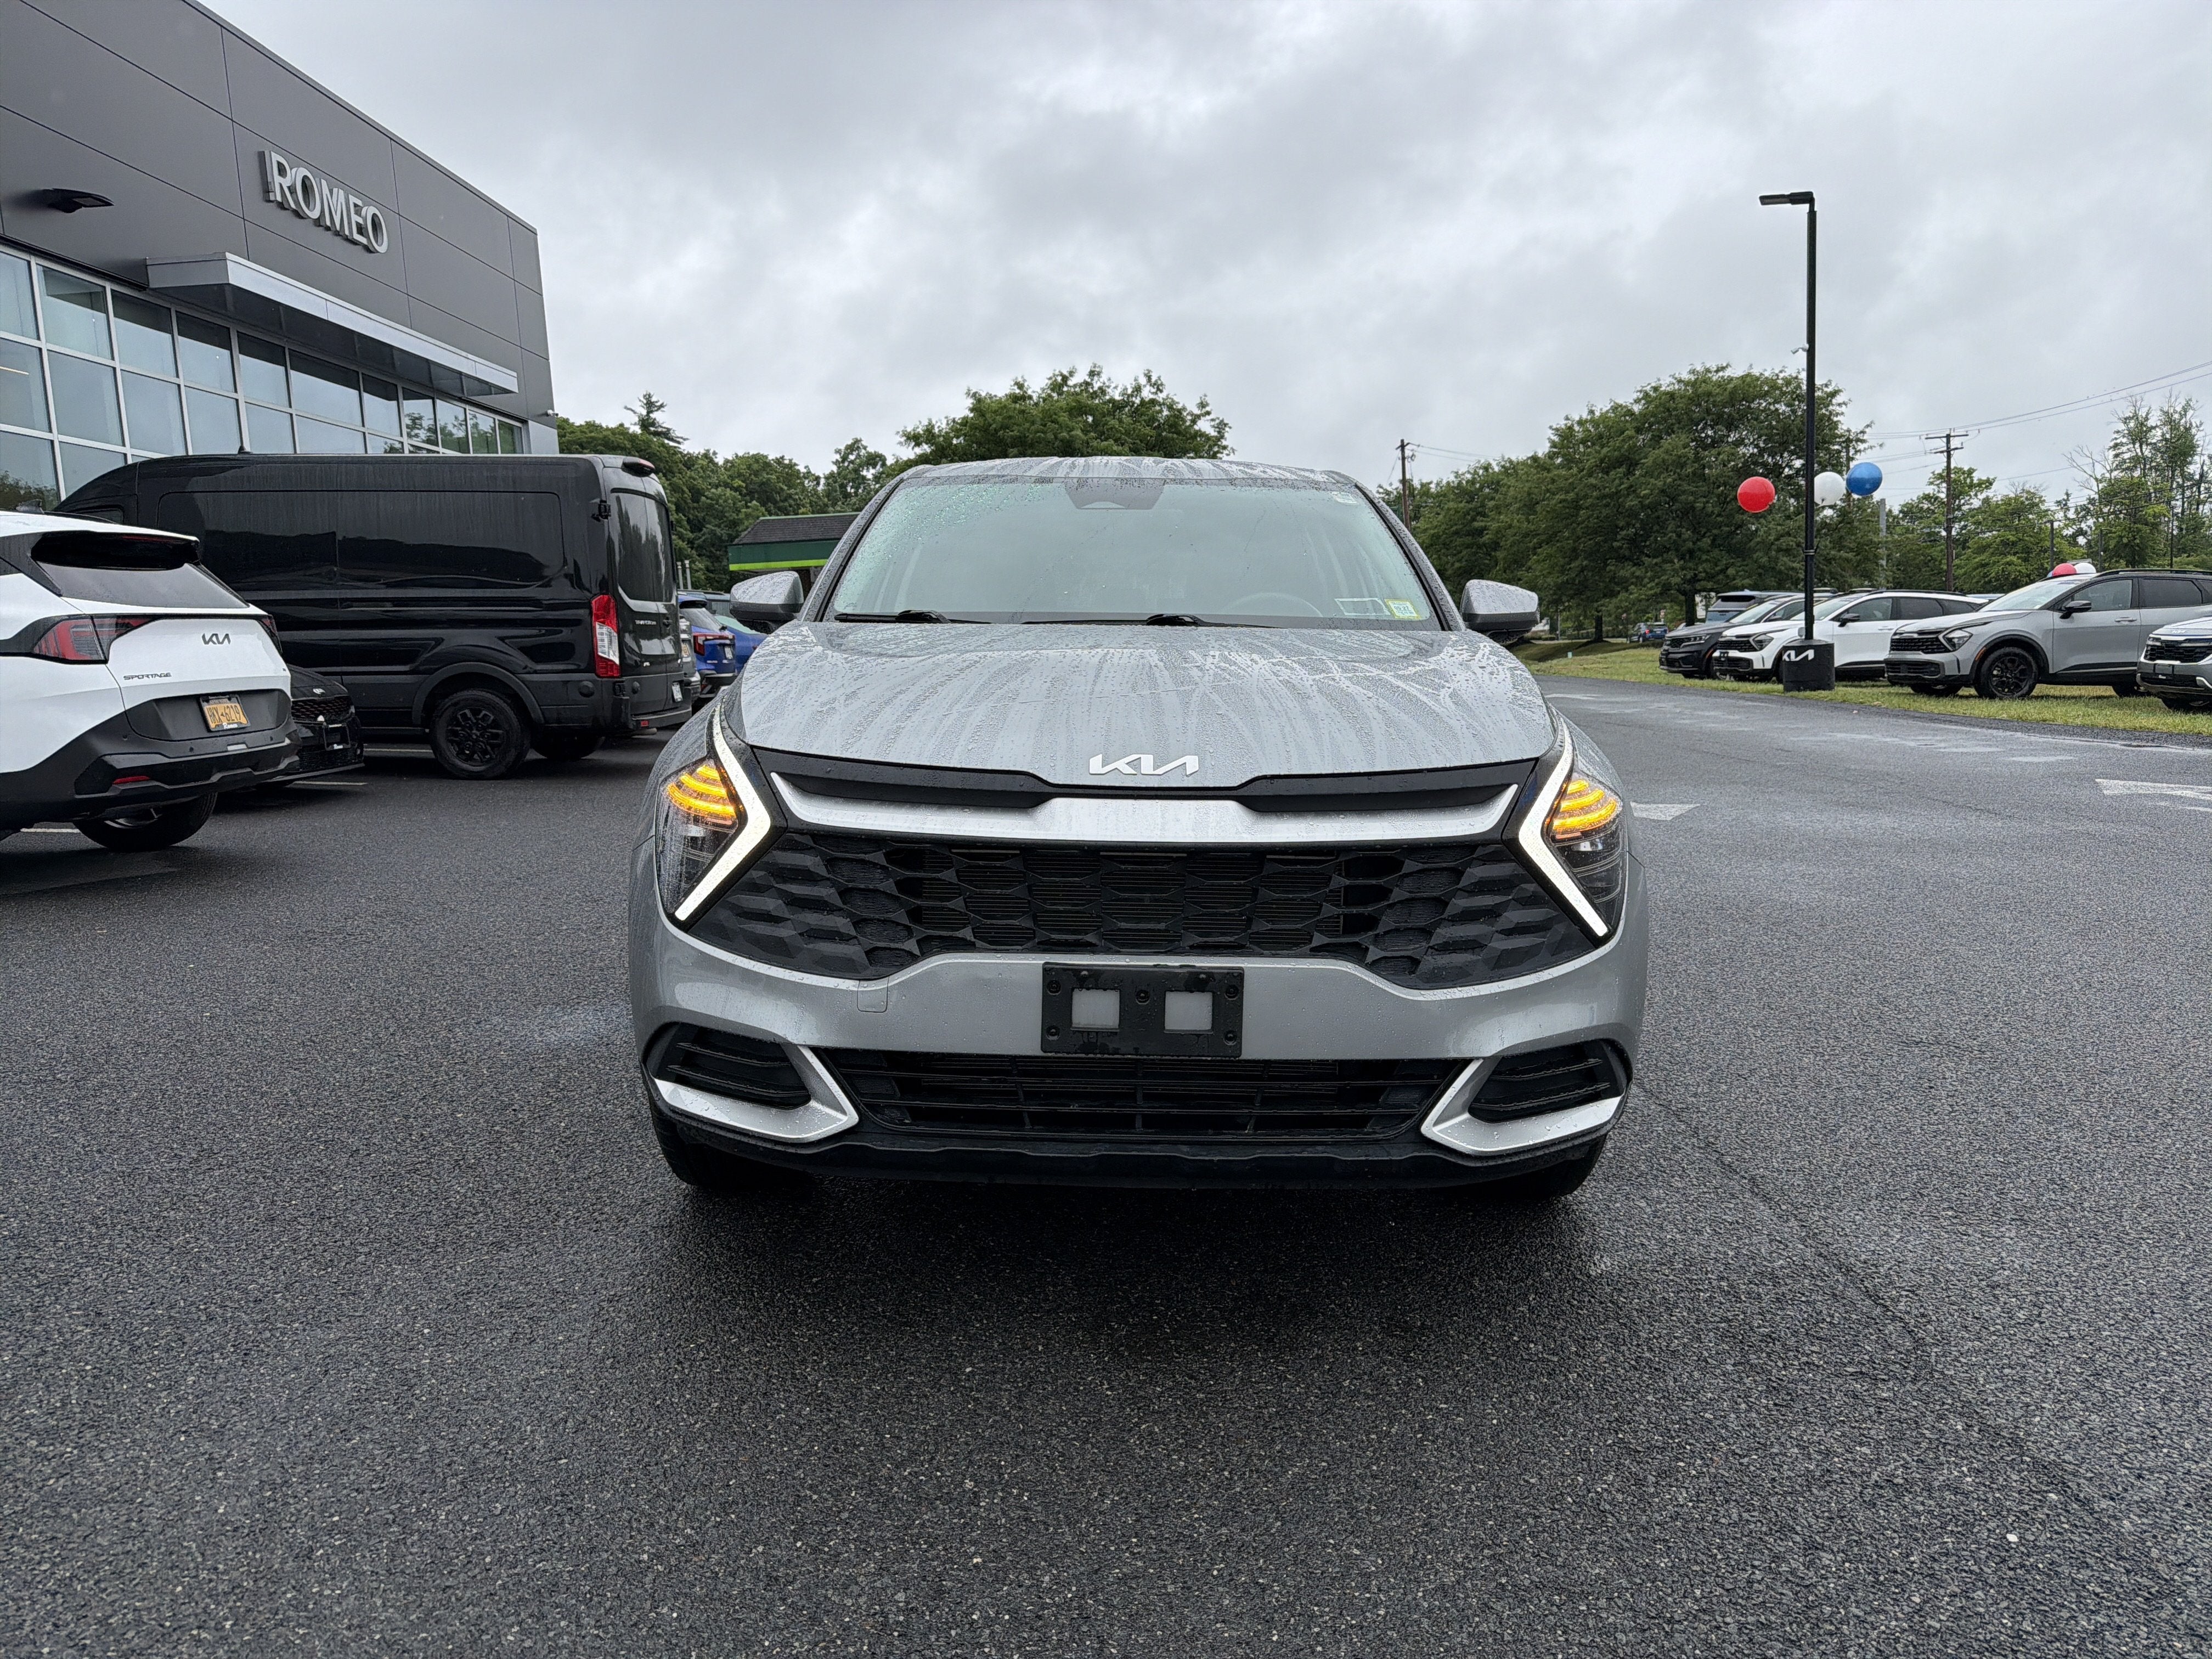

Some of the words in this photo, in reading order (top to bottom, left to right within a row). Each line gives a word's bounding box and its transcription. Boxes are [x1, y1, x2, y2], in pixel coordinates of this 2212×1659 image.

[263, 150, 388, 254] ROMEO
[201, 633, 231, 645] KIA
[123, 672, 172, 680] SPORTAGE
[224, 704, 241, 722] 6219
[1089, 753, 1199, 777] KIA
